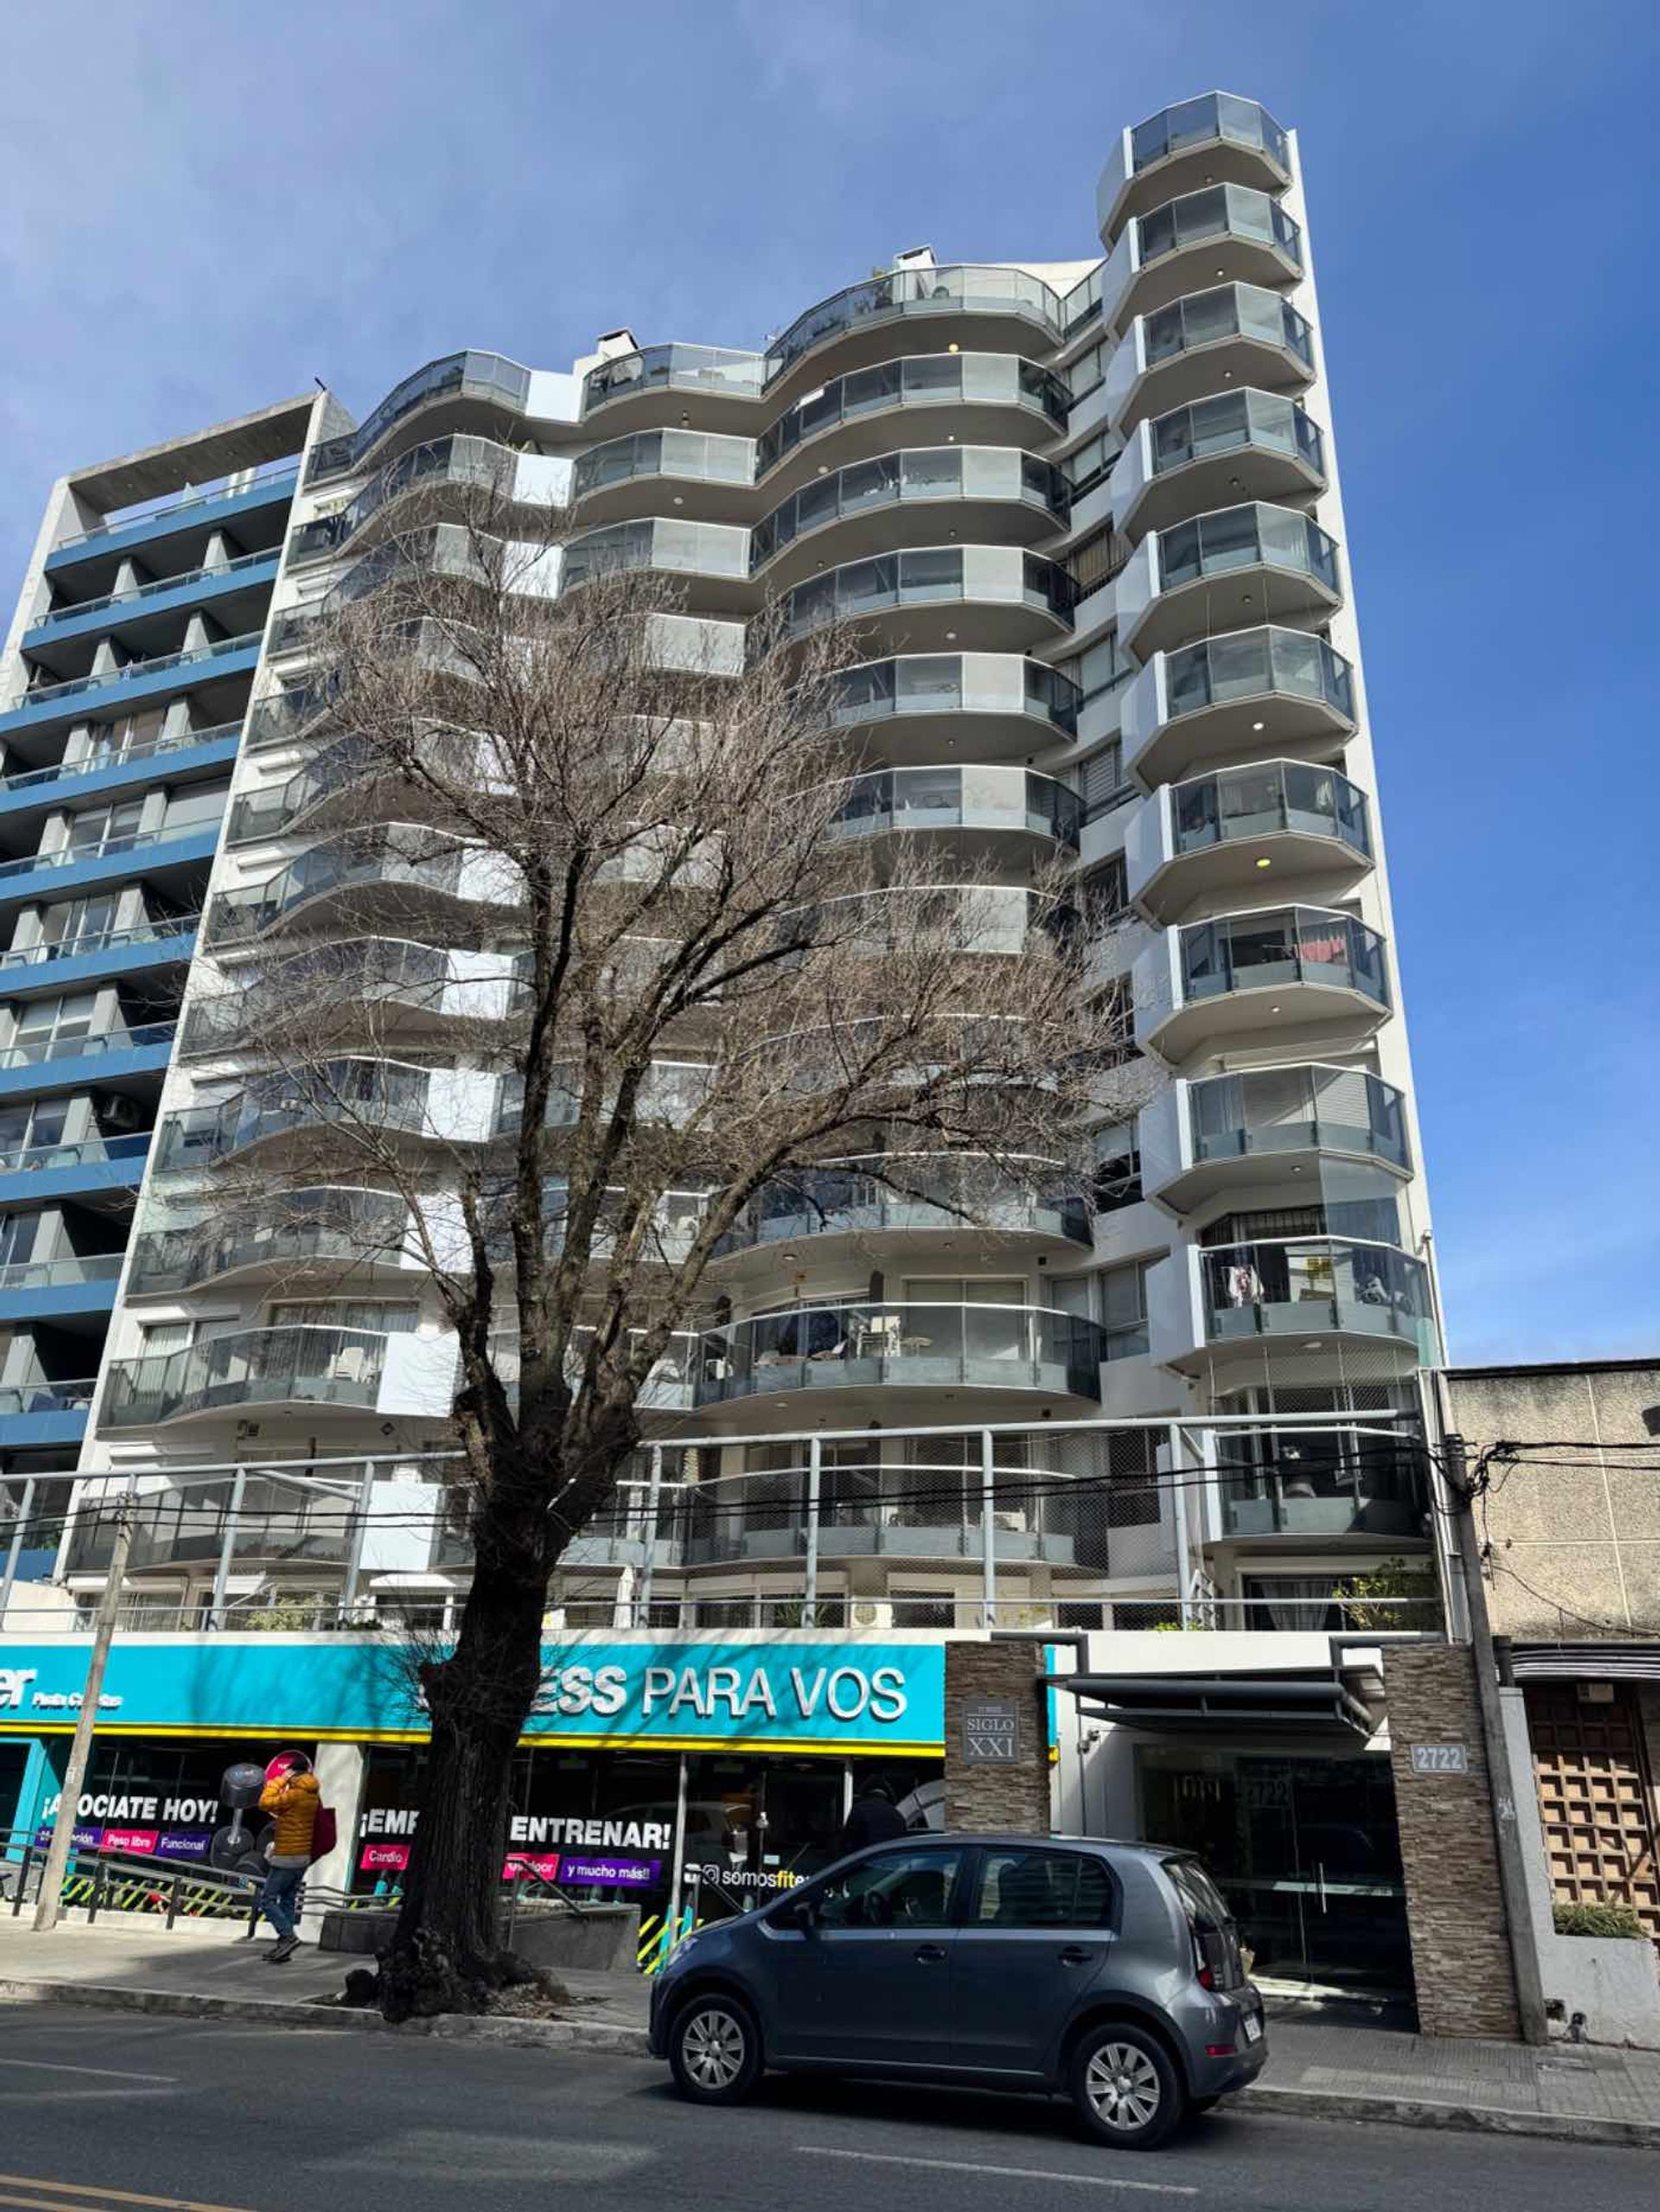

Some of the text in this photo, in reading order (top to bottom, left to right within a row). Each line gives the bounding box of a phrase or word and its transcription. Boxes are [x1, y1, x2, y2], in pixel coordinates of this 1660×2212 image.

[642, 1667, 776, 1718] PARA
[791, 1667, 907, 1720] VOS
[967, 1718, 1015, 1731] SIGLO
[968, 1737, 1014, 1757] XXI
[1417, 1747, 1462, 1769] 2722
[42, 1794, 219, 1824] ¡AOCIATE HOY!
[107, 1833, 152, 1849] Peso libre
[510, 1815, 672, 1851] ENTRENAR!
[160, 1837, 207, 1852] Funcional
[368, 1850, 403, 1864] Cardio
[567, 1865, 574, 1878] y
[577, 1865, 616, 1878] mucho
